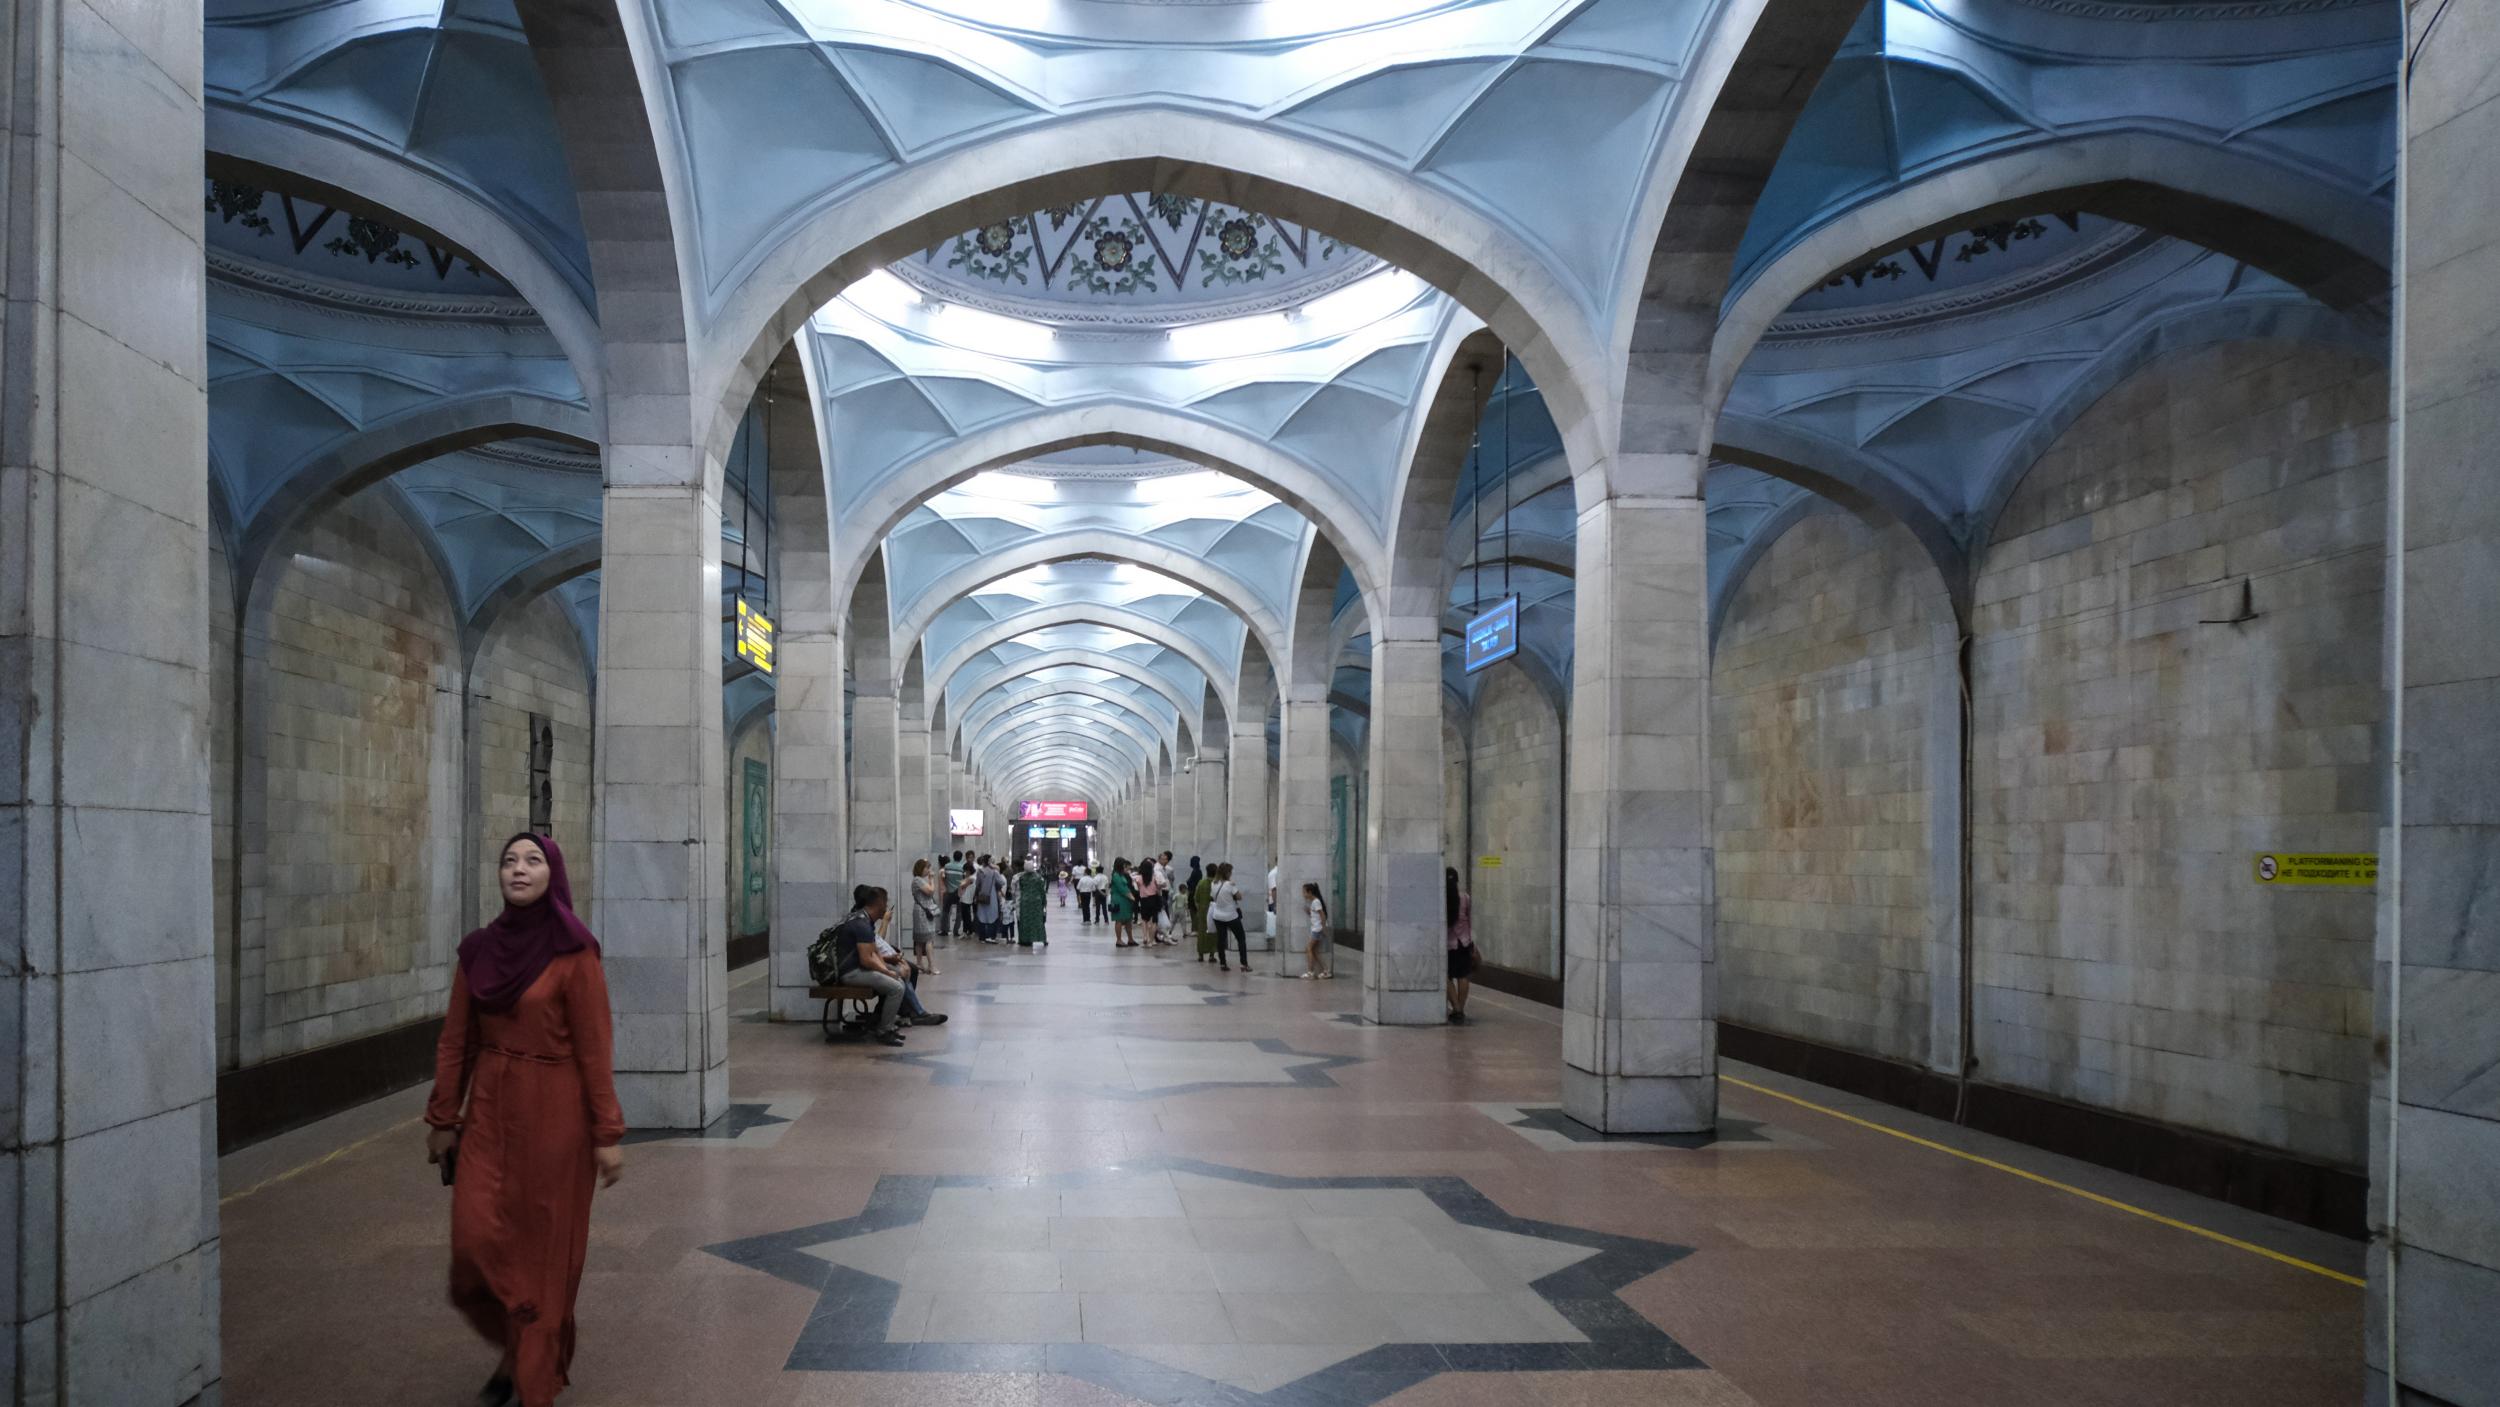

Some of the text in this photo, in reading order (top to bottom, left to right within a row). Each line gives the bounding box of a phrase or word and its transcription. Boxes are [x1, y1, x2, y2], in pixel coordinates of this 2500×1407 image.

[2288, 857, 2361, 866] PLATFORMANING
[2282, 869, 2292, 877] НЕ
[2297, 869, 2350, 878] ПОДХОДИТЕ
[2354, 869, 2361, 878] К
